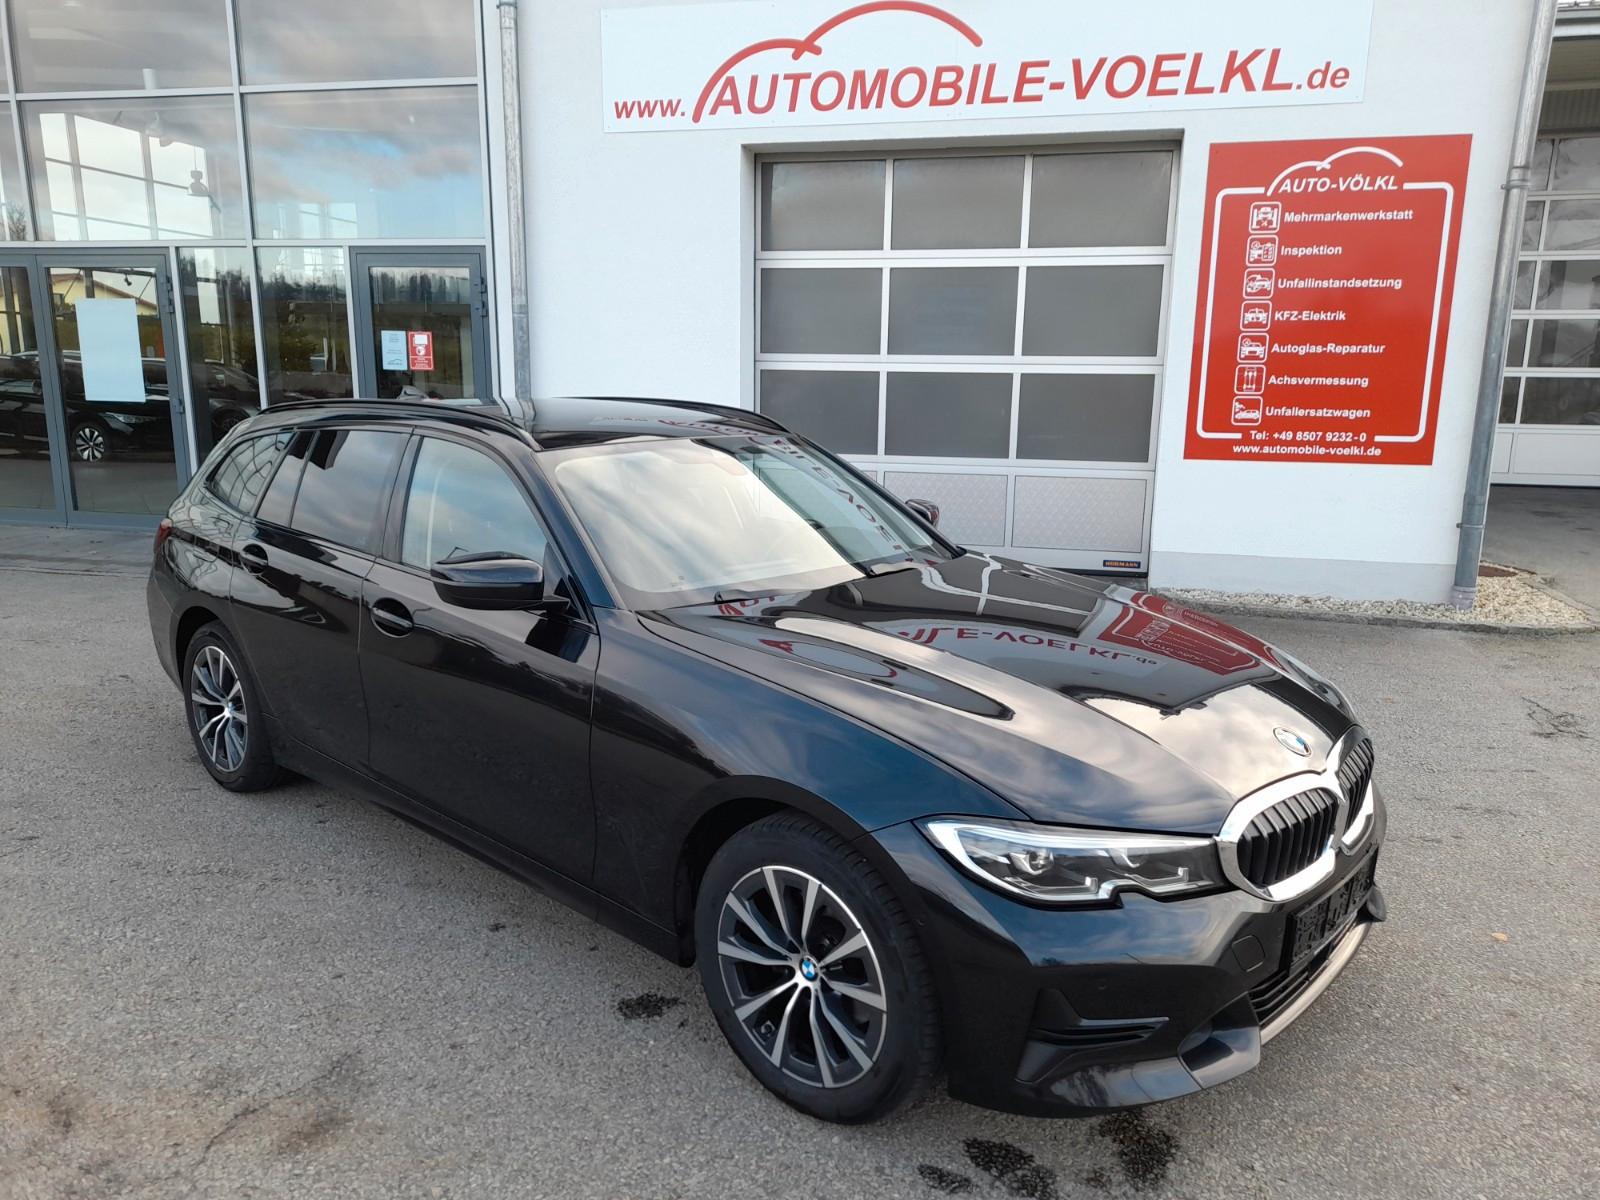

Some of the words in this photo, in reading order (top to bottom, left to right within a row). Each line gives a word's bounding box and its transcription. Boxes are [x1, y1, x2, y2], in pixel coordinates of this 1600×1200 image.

[1278, 174, 1399, 194] AUTO-VÖLKL
[1284, 209, 1414, 223] Mehrmarkenwerkstatt
[1280, 244, 1343, 257] Inspektion
[1277, 276, 1403, 290] Unfallinstandsetzung
[1274, 310, 1346, 322] KFZ-Elektrik
[1270, 342, 1386, 356] Autoglas-Reparatur
[1267, 374, 1370, 388] Achsvermessung
[1265, 406, 1371, 420] Unfallersatzwagen
[1249, 430, 1270, 441] Tel:
[1273, 431, 1293, 442] +49
[1295, 431, 1323, 443] 8507
[1325, 431, 1367, 443] 9232-0
[1232, 445, 1382, 457] www.automobile-voelkl.de
